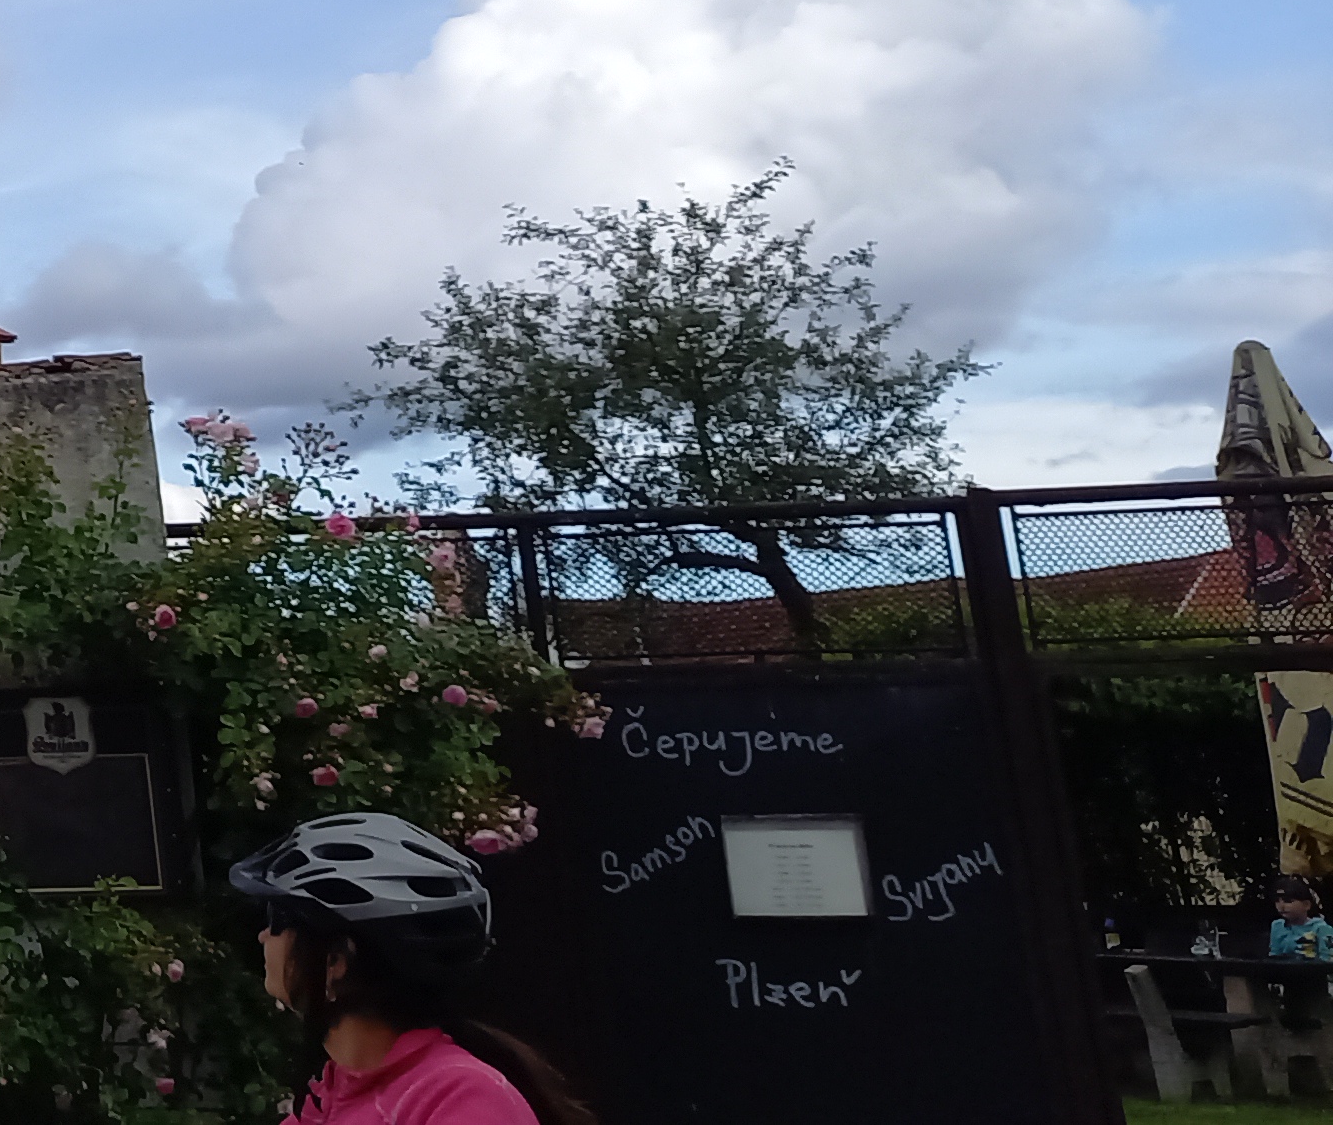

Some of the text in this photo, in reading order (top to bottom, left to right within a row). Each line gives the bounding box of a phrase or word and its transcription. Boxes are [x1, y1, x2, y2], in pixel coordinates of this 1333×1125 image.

[621, 705, 844, 776] Čepujeme
[601, 815, 716, 894] Samson
[715, 958, 862, 1008] Plzeň
